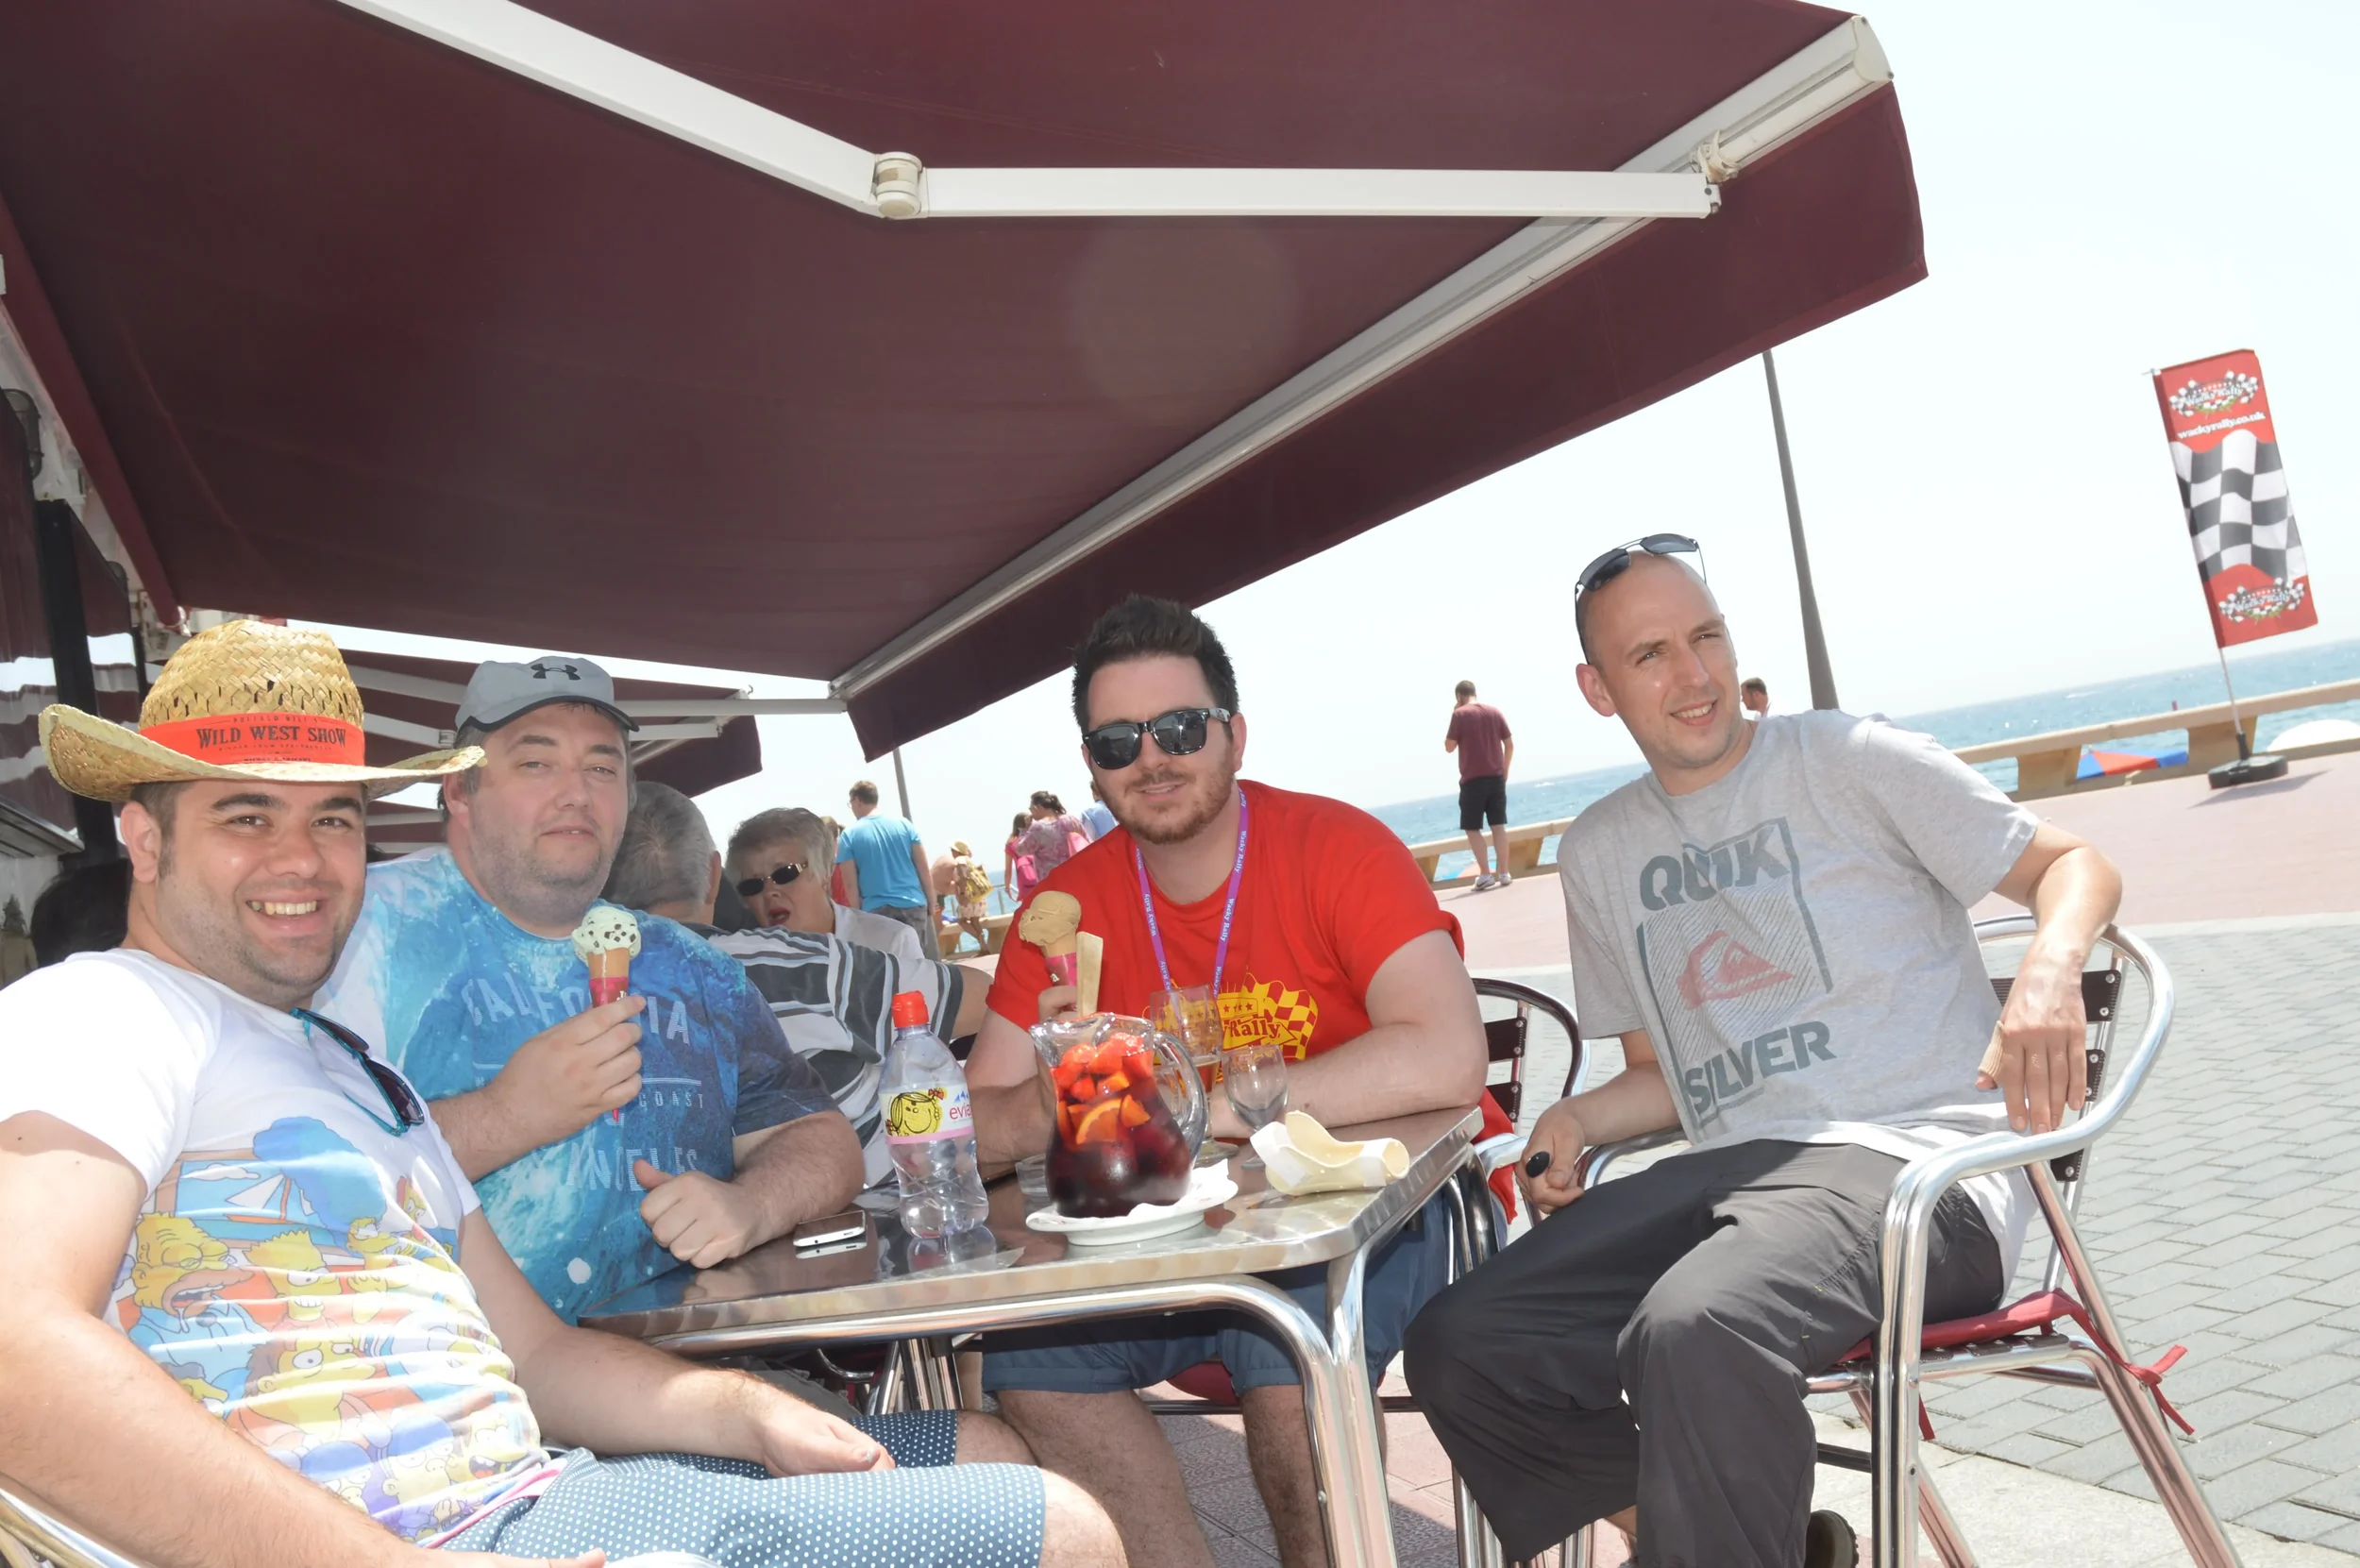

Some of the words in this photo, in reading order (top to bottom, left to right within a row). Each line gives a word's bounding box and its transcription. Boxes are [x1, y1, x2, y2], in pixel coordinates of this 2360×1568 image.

[195, 727, 242, 749] WILD
[249, 726, 300, 742] WEST
[308, 727, 346, 748] SHOW
[1238, 831, 1247, 852] Wacky
[1234, 852, 1244, 873] Rally
[1143, 893, 1154, 913] Rally
[1223, 898, 1235, 921] Wacky
[1146, 913, 1157, 936] Wacky
[1220, 921, 1231, 942] Rally
[1160, 960, 1171, 980] Rally
[1229, 1018, 1281, 1039] Rally
[1684, 1020, 1837, 1116] SILVER
[949, 1102, 972, 1121] evia
